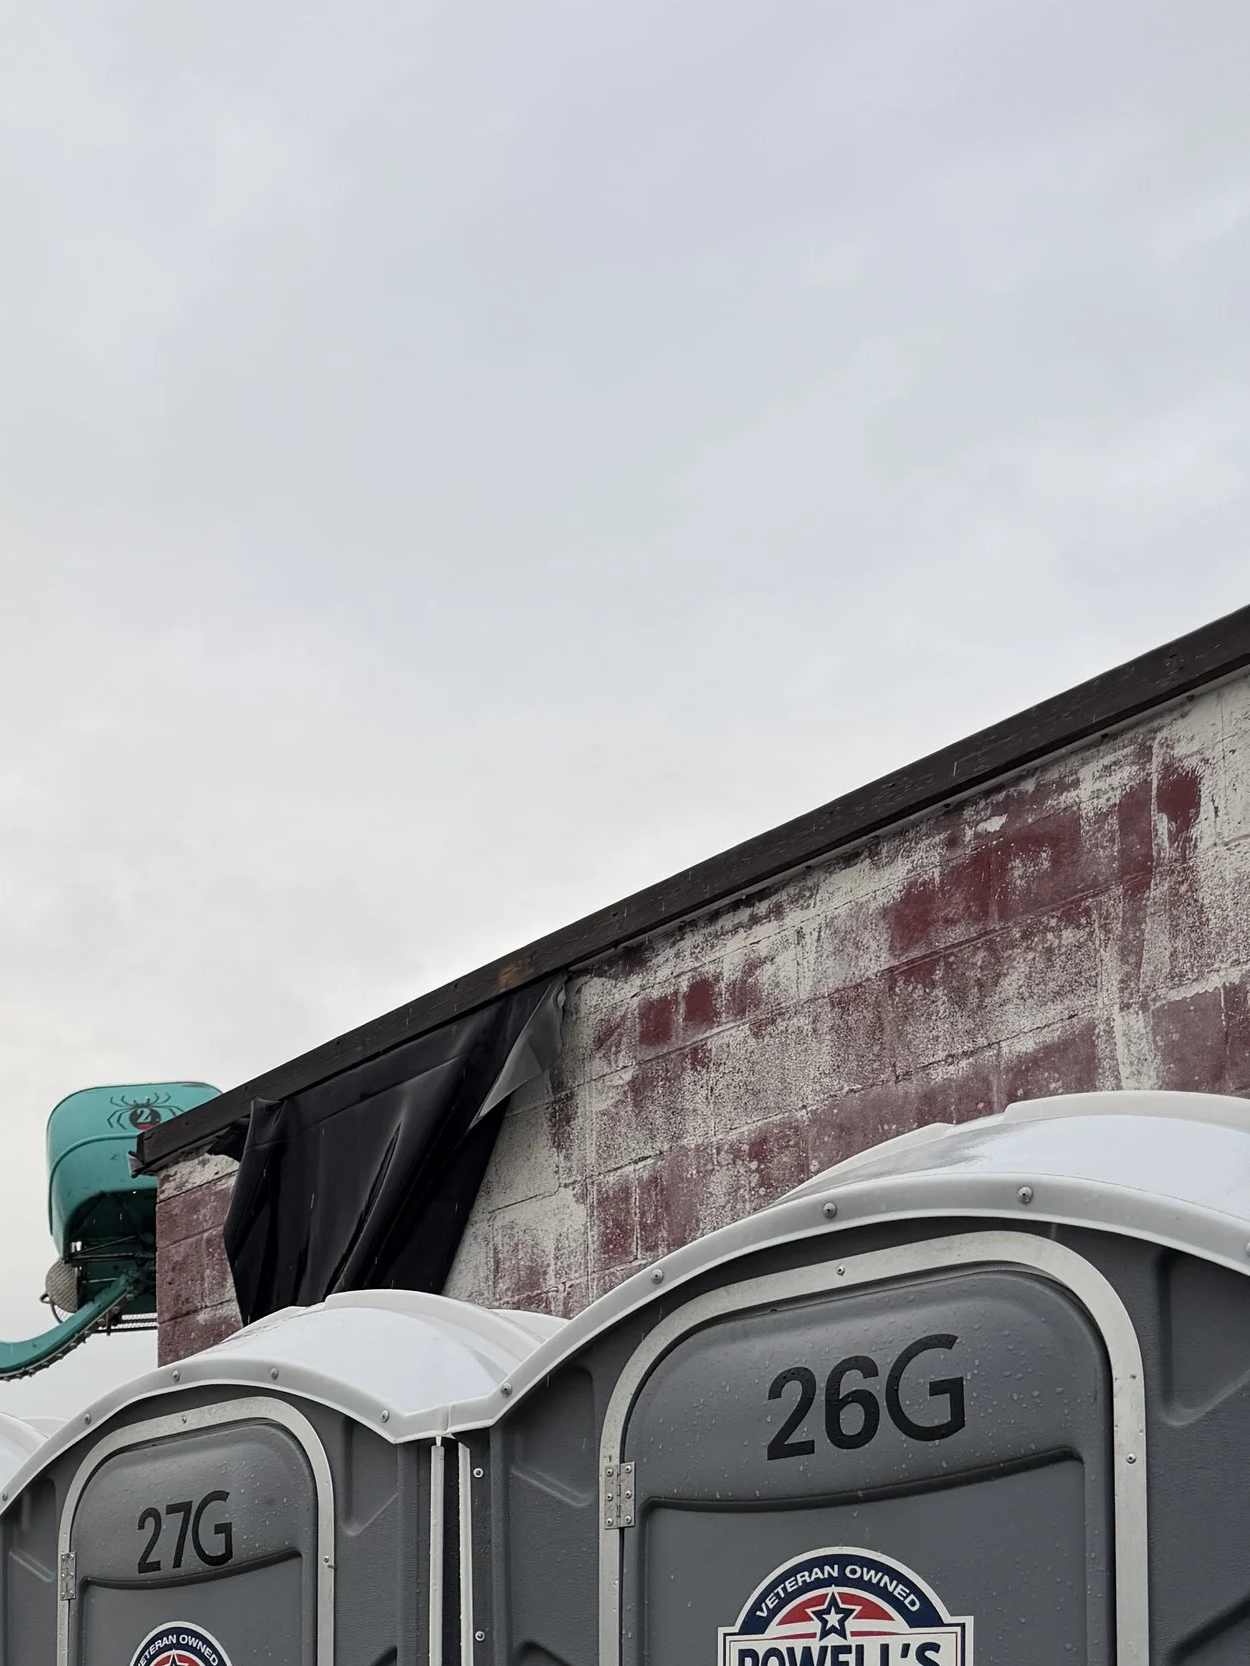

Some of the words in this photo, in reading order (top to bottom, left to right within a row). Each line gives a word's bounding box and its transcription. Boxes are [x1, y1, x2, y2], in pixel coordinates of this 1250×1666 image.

[137, 1108, 152, 1123] 2
[767, 1333, 966, 1461] 26G
[137, 1490, 234, 1574] 27G
[755, 1564, 839, 1620] VETERAN
[844, 1564, 922, 1613] OWNED
